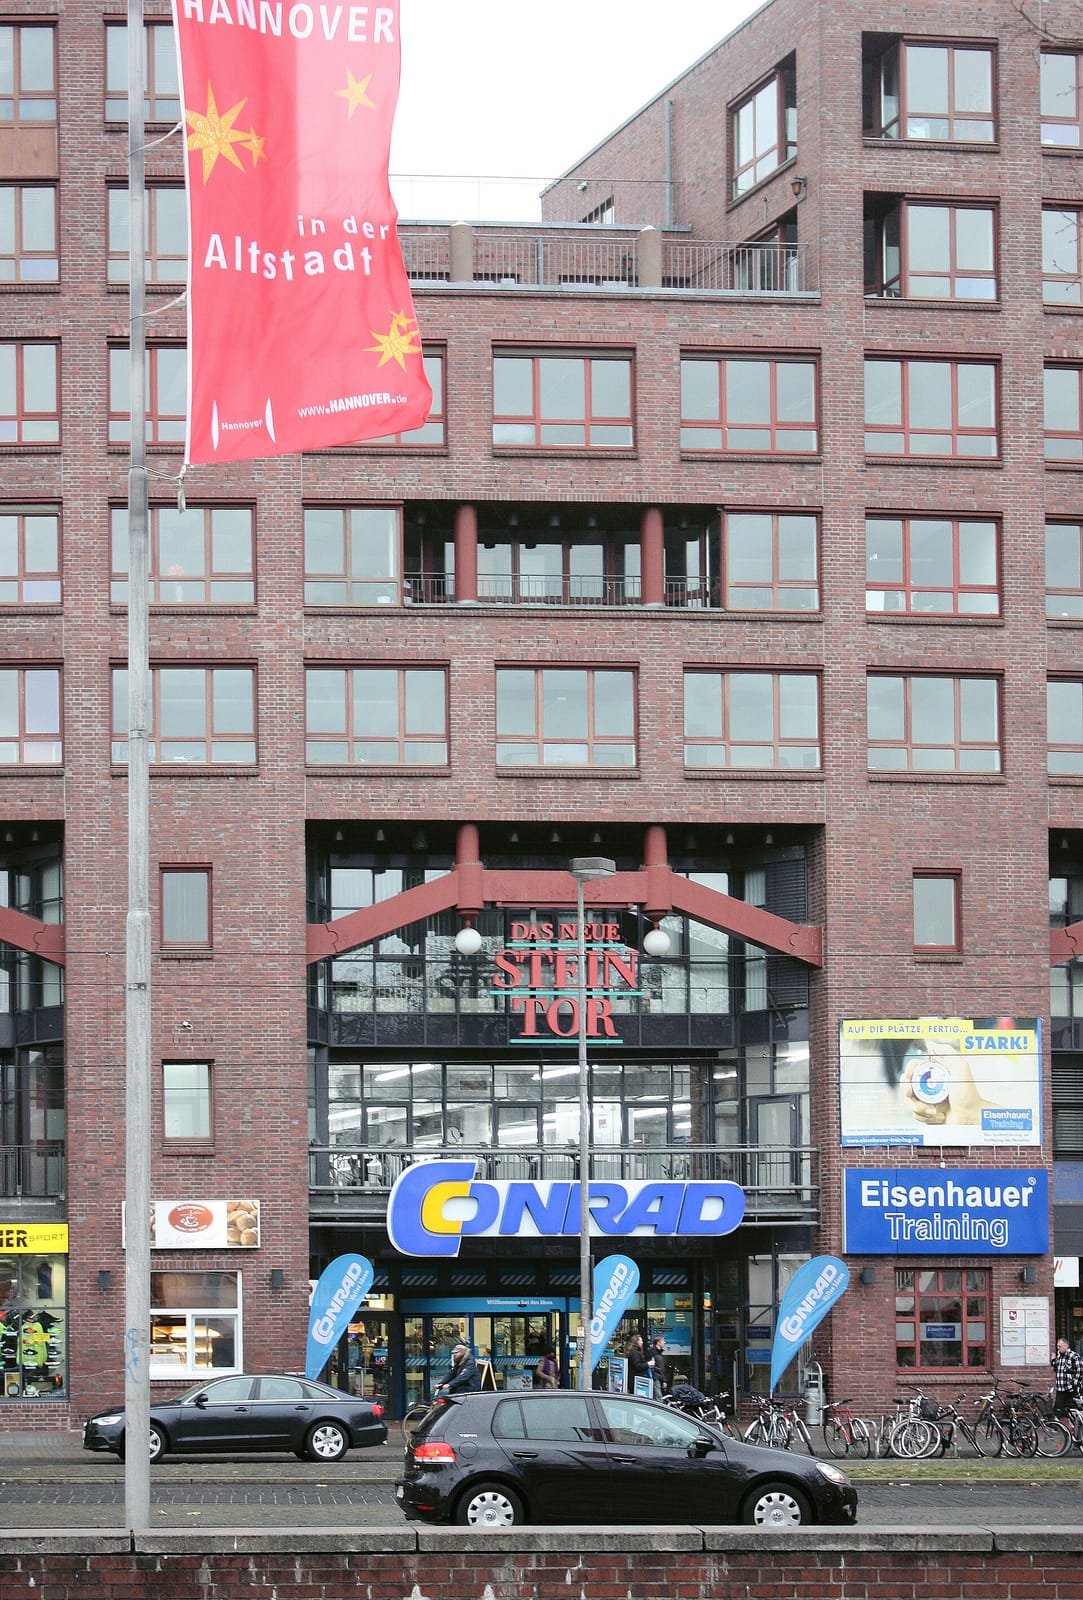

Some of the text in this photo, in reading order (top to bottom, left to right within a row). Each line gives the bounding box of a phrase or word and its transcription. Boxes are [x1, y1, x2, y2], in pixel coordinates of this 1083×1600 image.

[183, 0, 395, 43] HANNOVER
[298, 215, 389, 240] in der
[203, 233, 373, 281] Altstadt
[297, 392, 408, 418] www.HANNOVER.de
[221, 419, 263, 431] Hannover
[511, 922, 621, 940] DAS NEUE
[492, 949, 640, 989] STEIN
[512, 998, 618, 1037] TOR
[847, 1025, 866, 1034] AUF
[870, 1025, 884, 1033] DIE
[964, 1035, 1029, 1050] STARK!
[390, 1161, 746, 1256] CONRAD
[29, 1234, 65, 1242] SPORT
[884, 1212, 1009, 1247] Training
[311, 1263, 362, 1345] CONRAD
[780, 1264, 838, 1342] CONRAD
